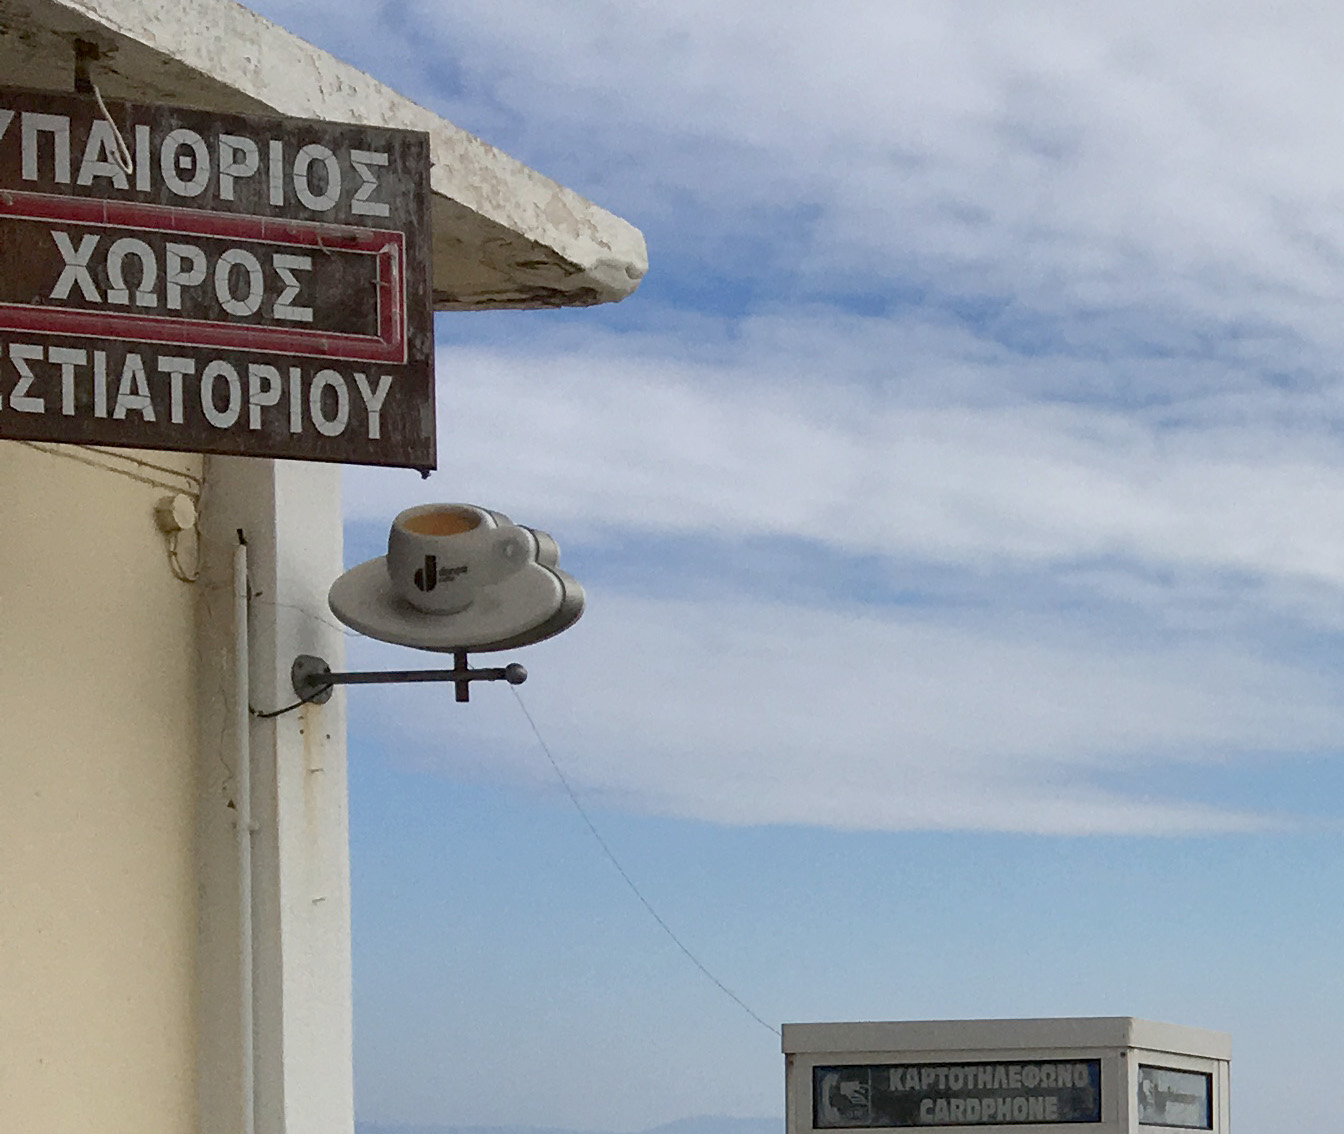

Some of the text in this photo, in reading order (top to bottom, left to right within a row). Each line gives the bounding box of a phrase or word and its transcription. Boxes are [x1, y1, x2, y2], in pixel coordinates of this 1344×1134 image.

[49, 230, 314, 322] ΧΩΡΟΣ
[0, 343, 393, 440] ΣΤΙΑΤΟΡΙΟΥ
[888, 1064, 1089, 1092] ΚΑΡΤΟΤΗΛΕΦΩΝΟ
[919, 1096, 1059, 1122] CARDPHONE
